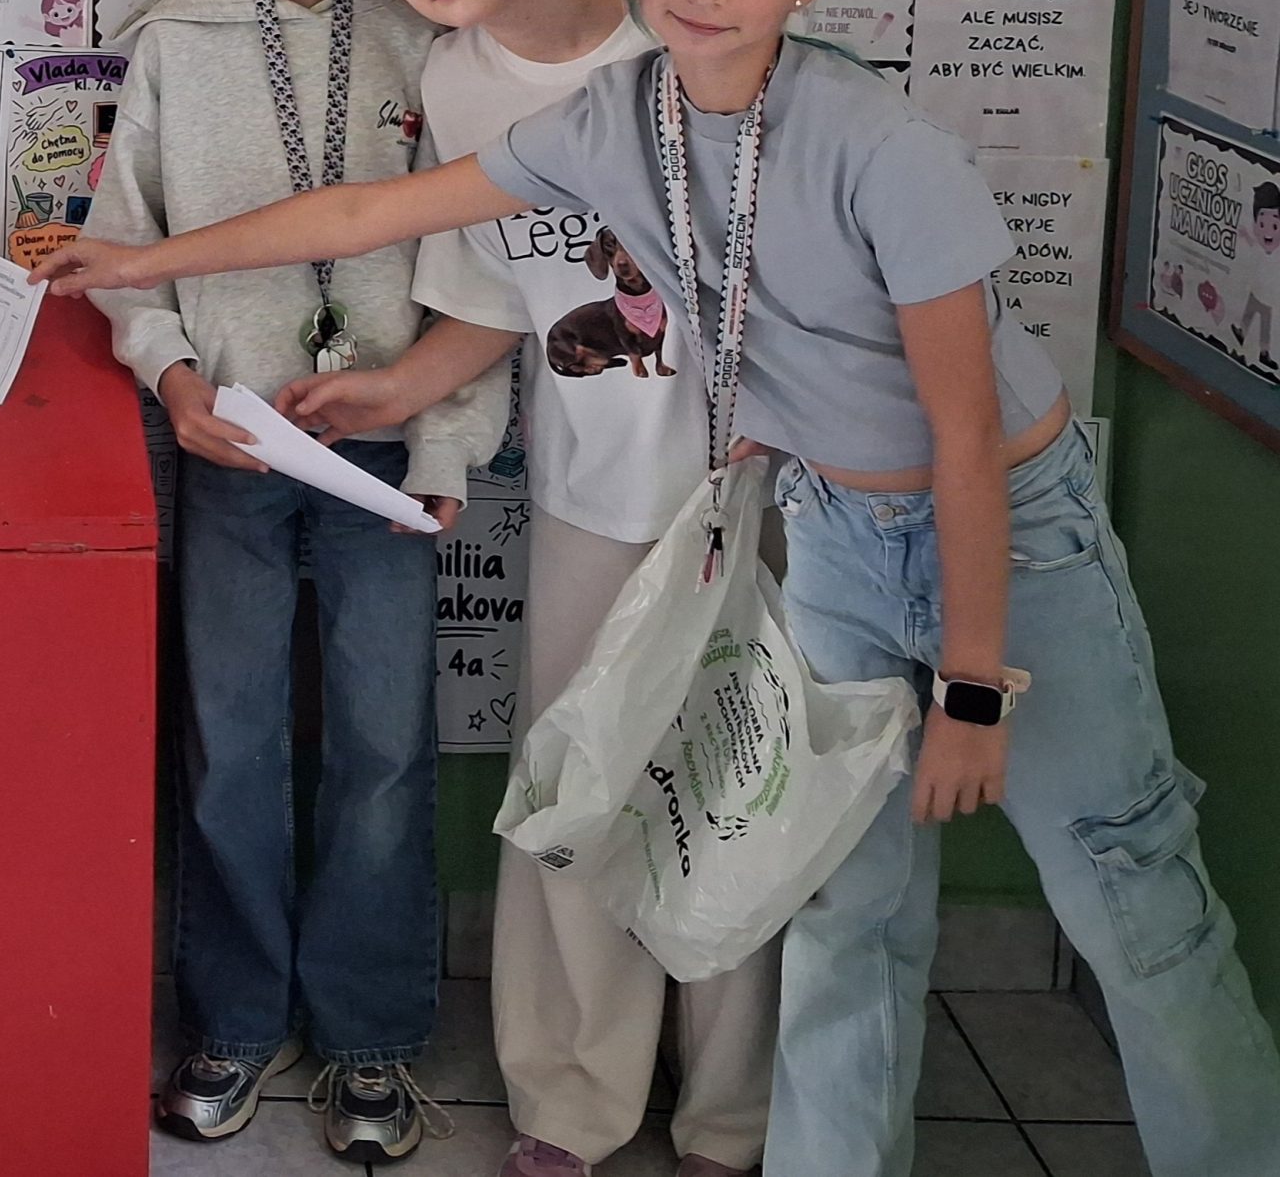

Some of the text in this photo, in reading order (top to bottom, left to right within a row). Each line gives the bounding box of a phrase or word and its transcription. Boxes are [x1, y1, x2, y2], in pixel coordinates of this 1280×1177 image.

[961, 10, 1063, 25] ALE MUSISZ
[1203, 6, 1259, 37] TWORZENIE
[968, 35, 1044, 52] ZACZĄĆ,
[29, 60, 90, 83] Vlada
[929, 61, 1086, 78] ABY BYĆ WIELKIM.
[75, 78, 113, 92] kl. 7a
[41, 135, 77, 150] Chętna
[32, 147, 84, 164] do pomocy
[1022, 192, 1072, 208] NIGDY
[16, 235, 45, 247] Dbam
[1008, 270, 1073, 287] ZGODZI
[448, 648, 484, 678] 4a
[644, 761, 691, 878] dronka
